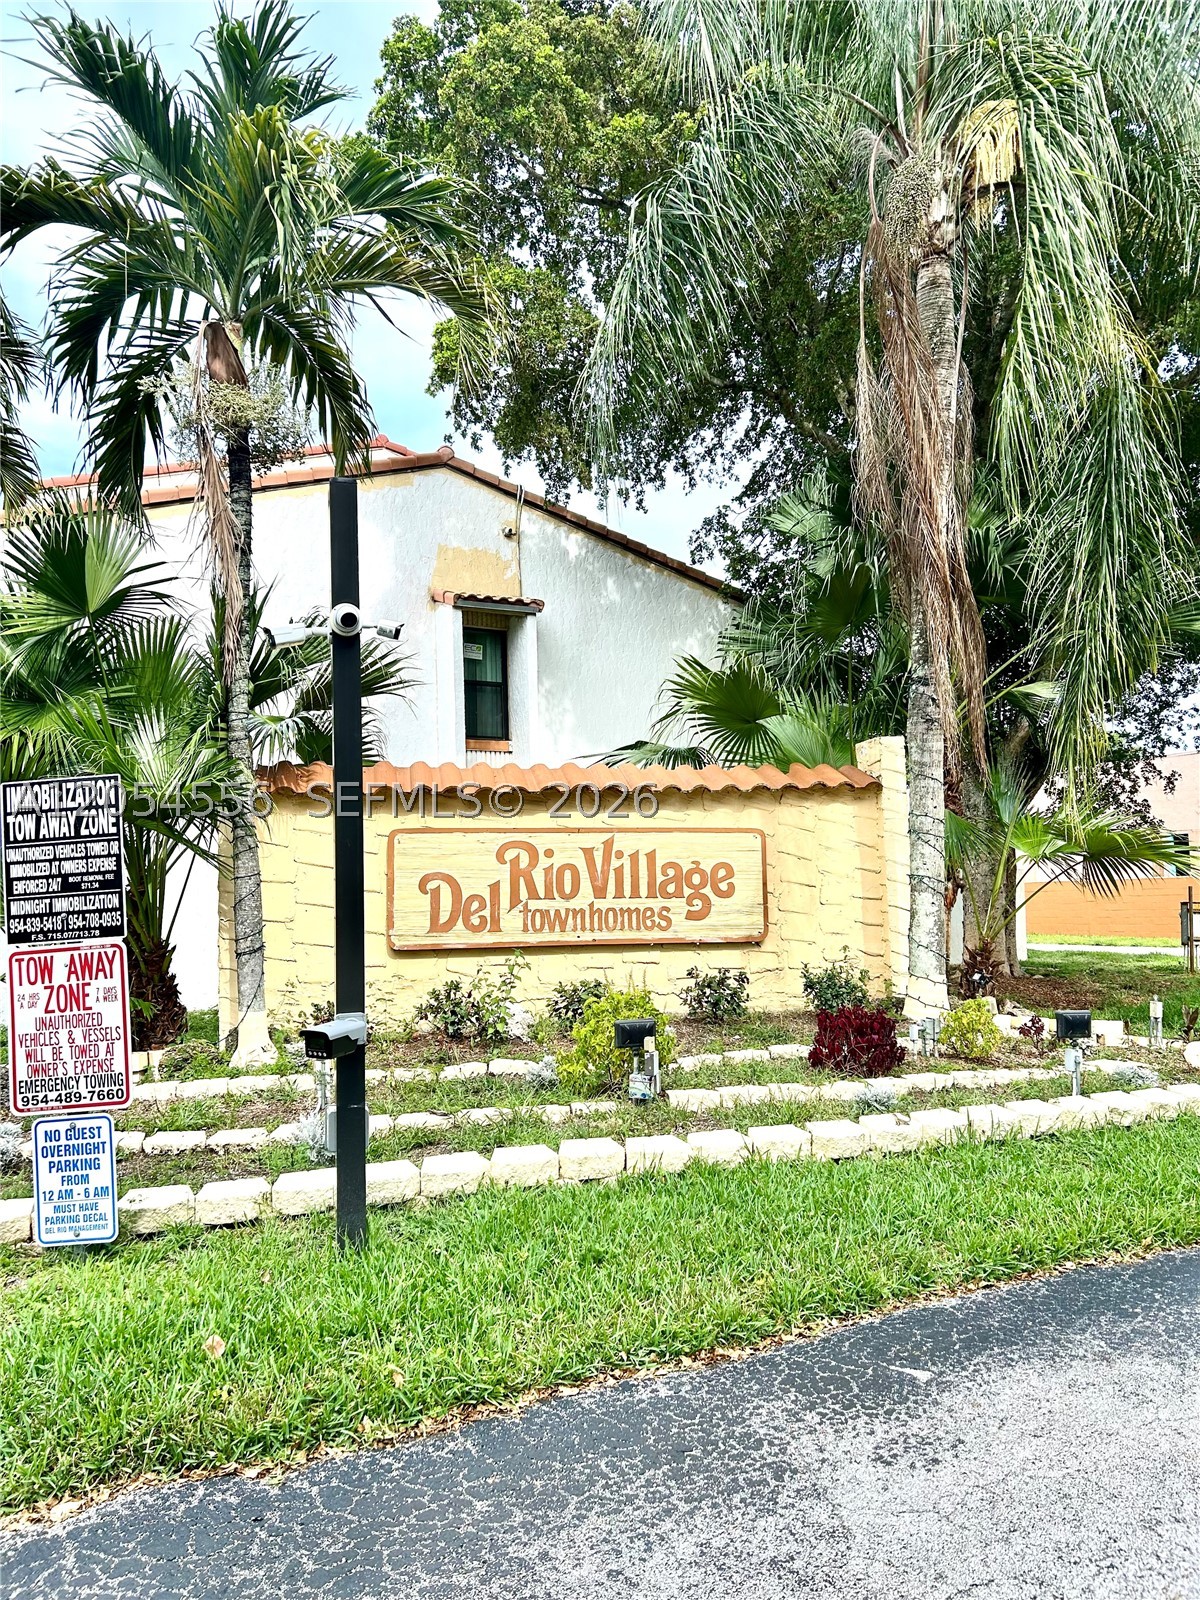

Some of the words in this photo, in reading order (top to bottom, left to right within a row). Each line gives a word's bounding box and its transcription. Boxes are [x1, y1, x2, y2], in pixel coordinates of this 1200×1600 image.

[6, 779, 116, 813] IMMOBILIZATION
[6, 814, 36, 842] TOW
[39, 810, 76, 839] AWAY
[80, 808, 117, 836] ZONE
[6, 846, 54, 862] UNAUTHORIZED
[55, 843, 86, 858] VEHICLES
[86, 842, 108, 856] TOWED
[110, 841, 119, 854] OR
[10, 862, 50, 878] IMMOBILIZED
[51, 861, 60, 875] AT
[60, 859, 87, 874] OWNERS
[88, 857, 116, 872] EXPENSE
[13, 879, 47, 894] ENFORCED
[418, 871, 504, 934] Del
[496, 840, 580, 914] Rio
[578, 834, 736, 921] Village
[10, 899, 50, 916] MIDNIGHT
[52, 894, 119, 912] IMMOBILIZATION
[10, 916, 62, 934] 954-839-5418
[68, 911, 121, 929] 954-708-0935
[519, 900, 672, 932] townhomes
[32, 933, 46, 941] F.S.
[48, 930, 100, 939] 715.07/713.78
[15, 955, 54, 986] TOW
[67, 950, 117, 982] AWAY
[17, 994, 25, 1002] 24
[44, 982, 92, 1014] ZONE
[103, 986, 118, 994] DAYS
[103, 994, 118, 1002] WEEK
[28, 1000, 38, 1009] DAY
[35, 1012, 103, 1032] UNAUTHORIZED
[18, 1031, 60, 1048] VEHICLES
[68, 1030, 75, 1044] &
[82, 1026, 121, 1043] VESSELS
[25, 1048, 46, 1063] WILL
[52, 1046, 63, 1061] BE
[69, 1044, 100, 1060] TOWED
[106, 1042, 115, 1057] AT
[27, 1062, 68, 1079] OWNER'S
[74, 1058, 115, 1075] EXPENSE
[19, 1076, 80, 1094] EMERGENCY
[84, 1072, 124, 1089] TOWING
[21, 1088, 124, 1106] 954-489-7660
[44, 1129, 60, 1143] NO
[65, 1126, 102, 1141] GUEST
[41, 1141, 106, 1158] OVERNIGHT
[48, 1158, 100, 1174] PARKING
[61, 1174, 89, 1186] FROM
[42, 1191, 54, 1201] 12
[58, 1189, 74, 1200] AM
[84, 1188, 90, 1198] 6
[94, 1186, 109, 1198] AM
[54, 1204, 76, 1214] MUST
[79, 1202, 99, 1212] HAVE
[45, 1215, 80, 1225] PARKING
[83, 1213, 108, 1222] DECAL
[68, 1223, 108, 1232] MANAGEMENT
